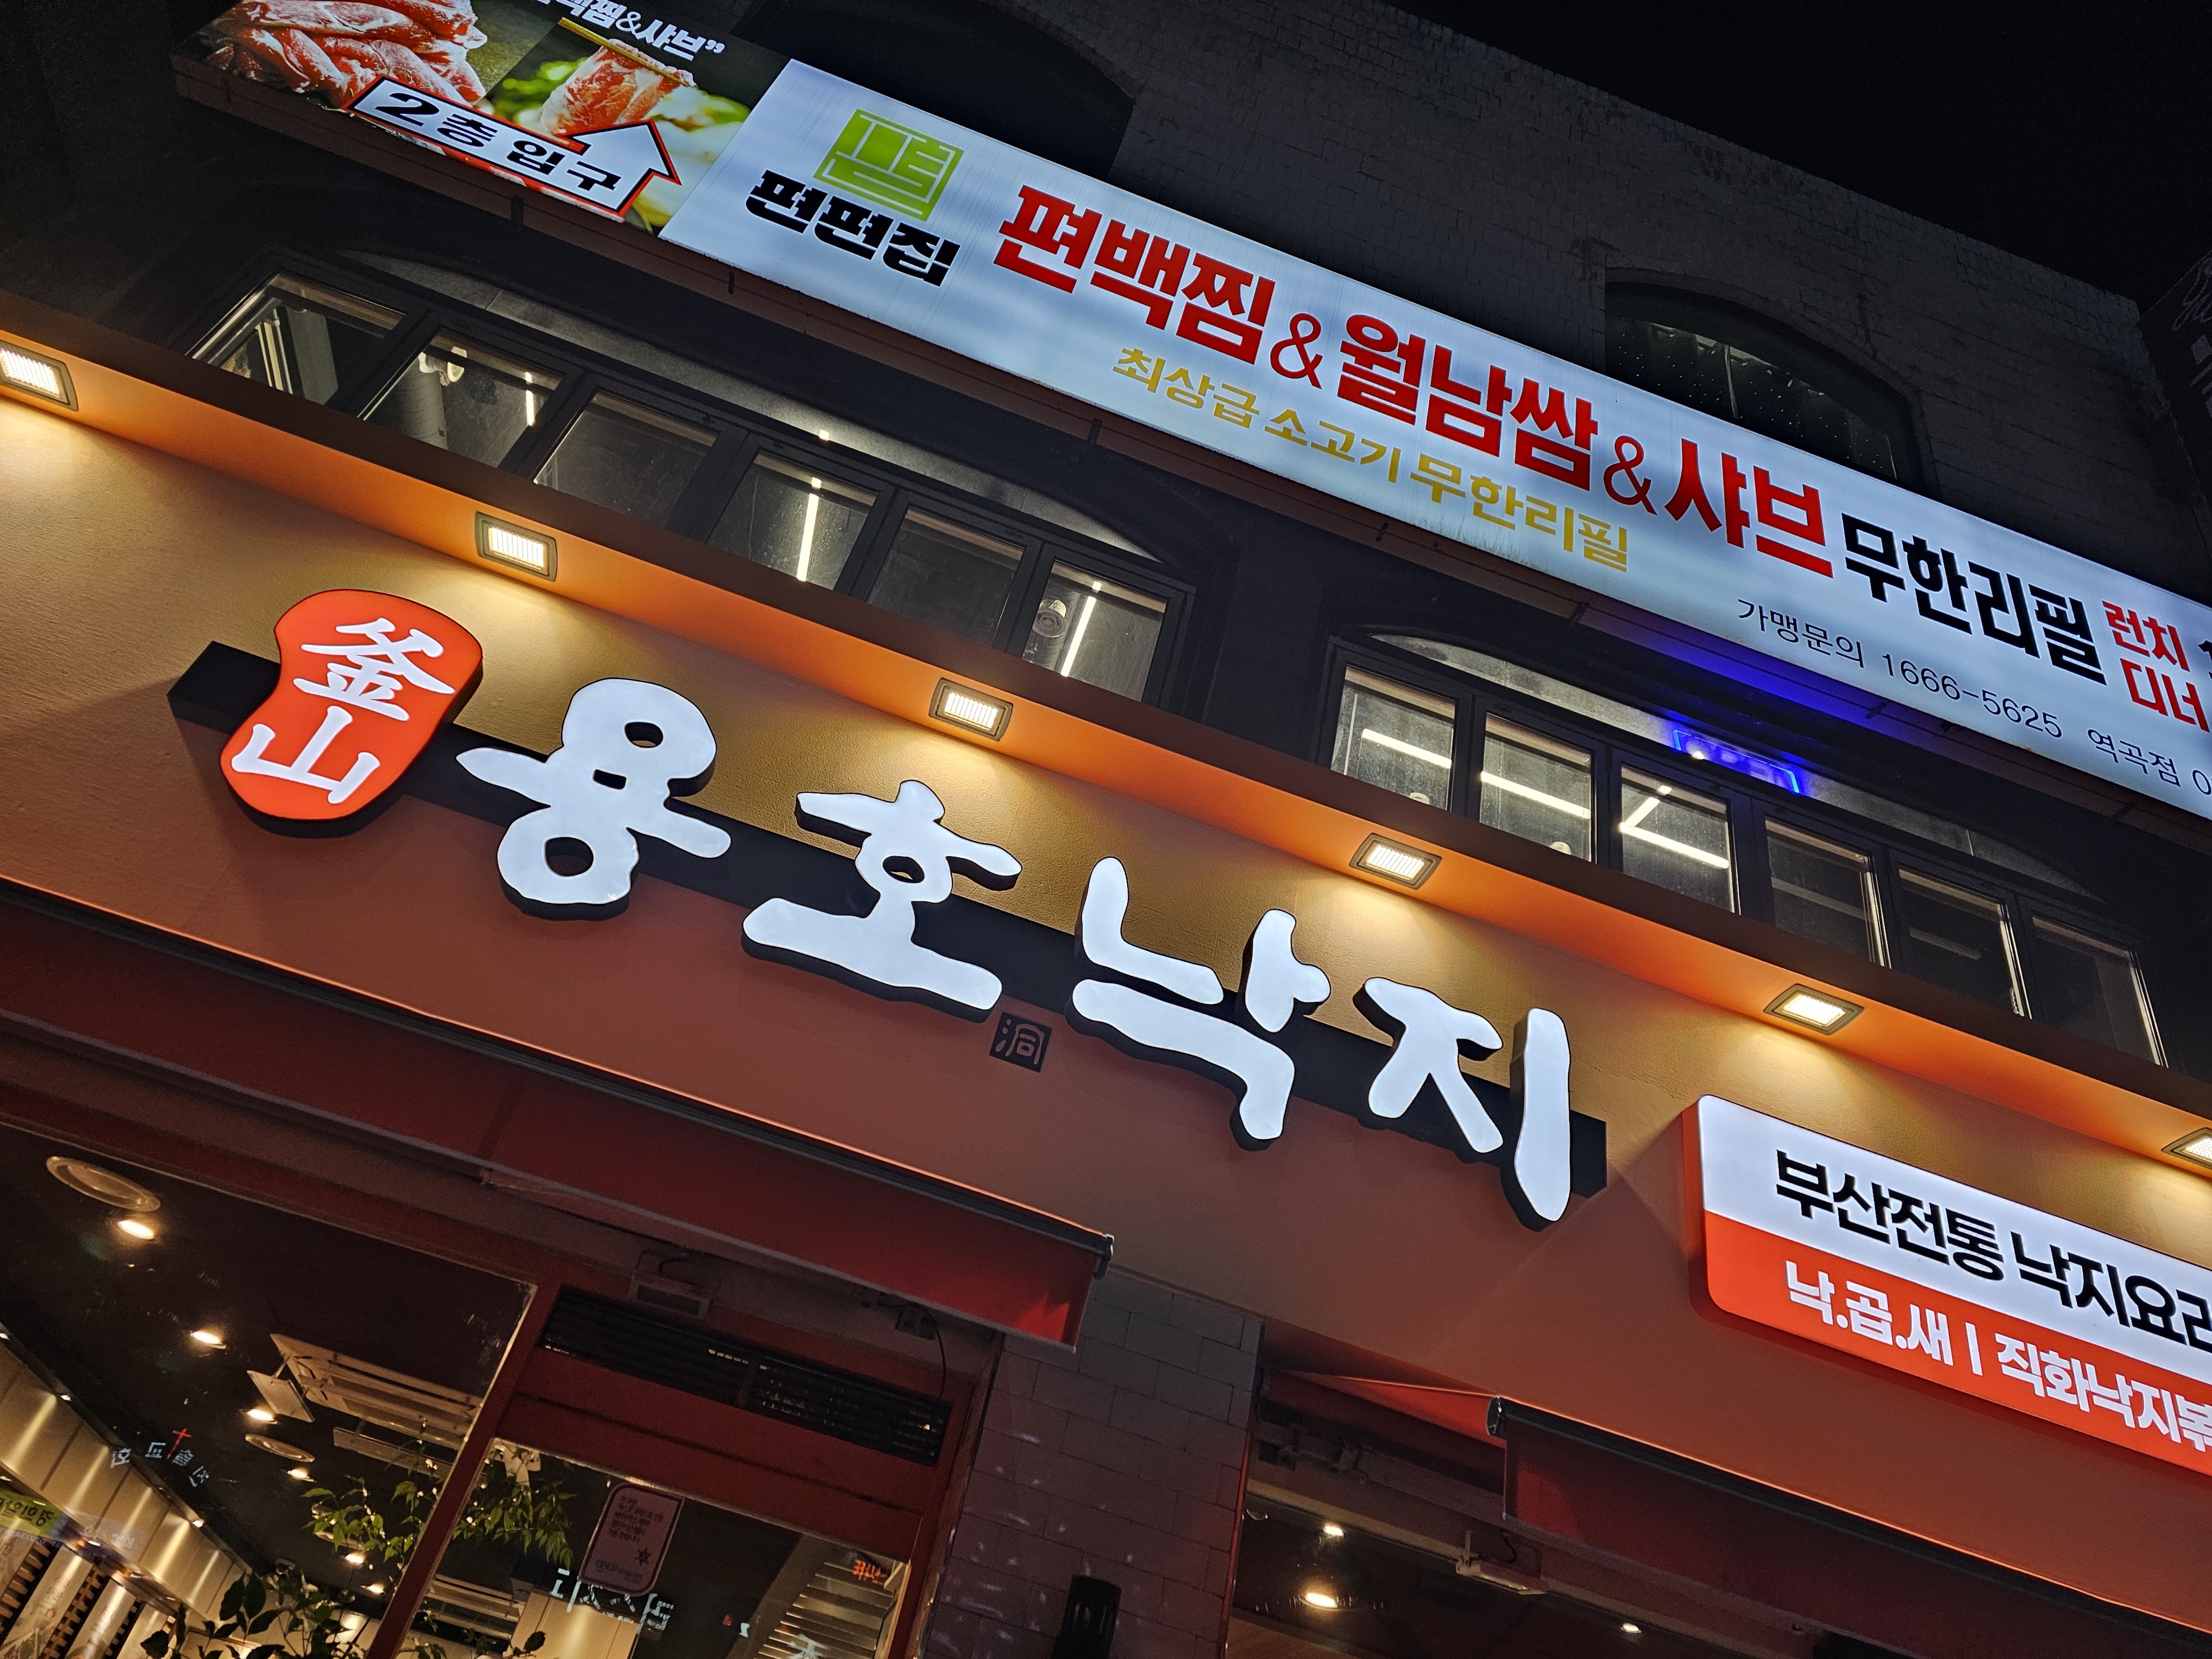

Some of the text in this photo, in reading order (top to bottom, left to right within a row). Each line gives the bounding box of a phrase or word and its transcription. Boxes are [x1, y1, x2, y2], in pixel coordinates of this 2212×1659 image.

[375, 92, 622, 191] 2층 입구
[745, 169, 961, 287] 편편집
[1113, 348, 1627, 572] 최상급 소고기 무한리필
[1841, 513, 2107, 686] 무한리필
[2101, 600, 2190, 672] 런치
[231, 618, 455, 804] 釜山
[1738, 598, 1865, 669] 가맹문의
[1882, 654, 2063, 738] 1666-5625
[2088, 729, 2181, 787] 역곡점
[2120, 658, 2210, 732] 디너
[1776, 1150, 2004, 1281] 부산전통
[1786, 1260, 1954, 1366] 낙.곱.새
